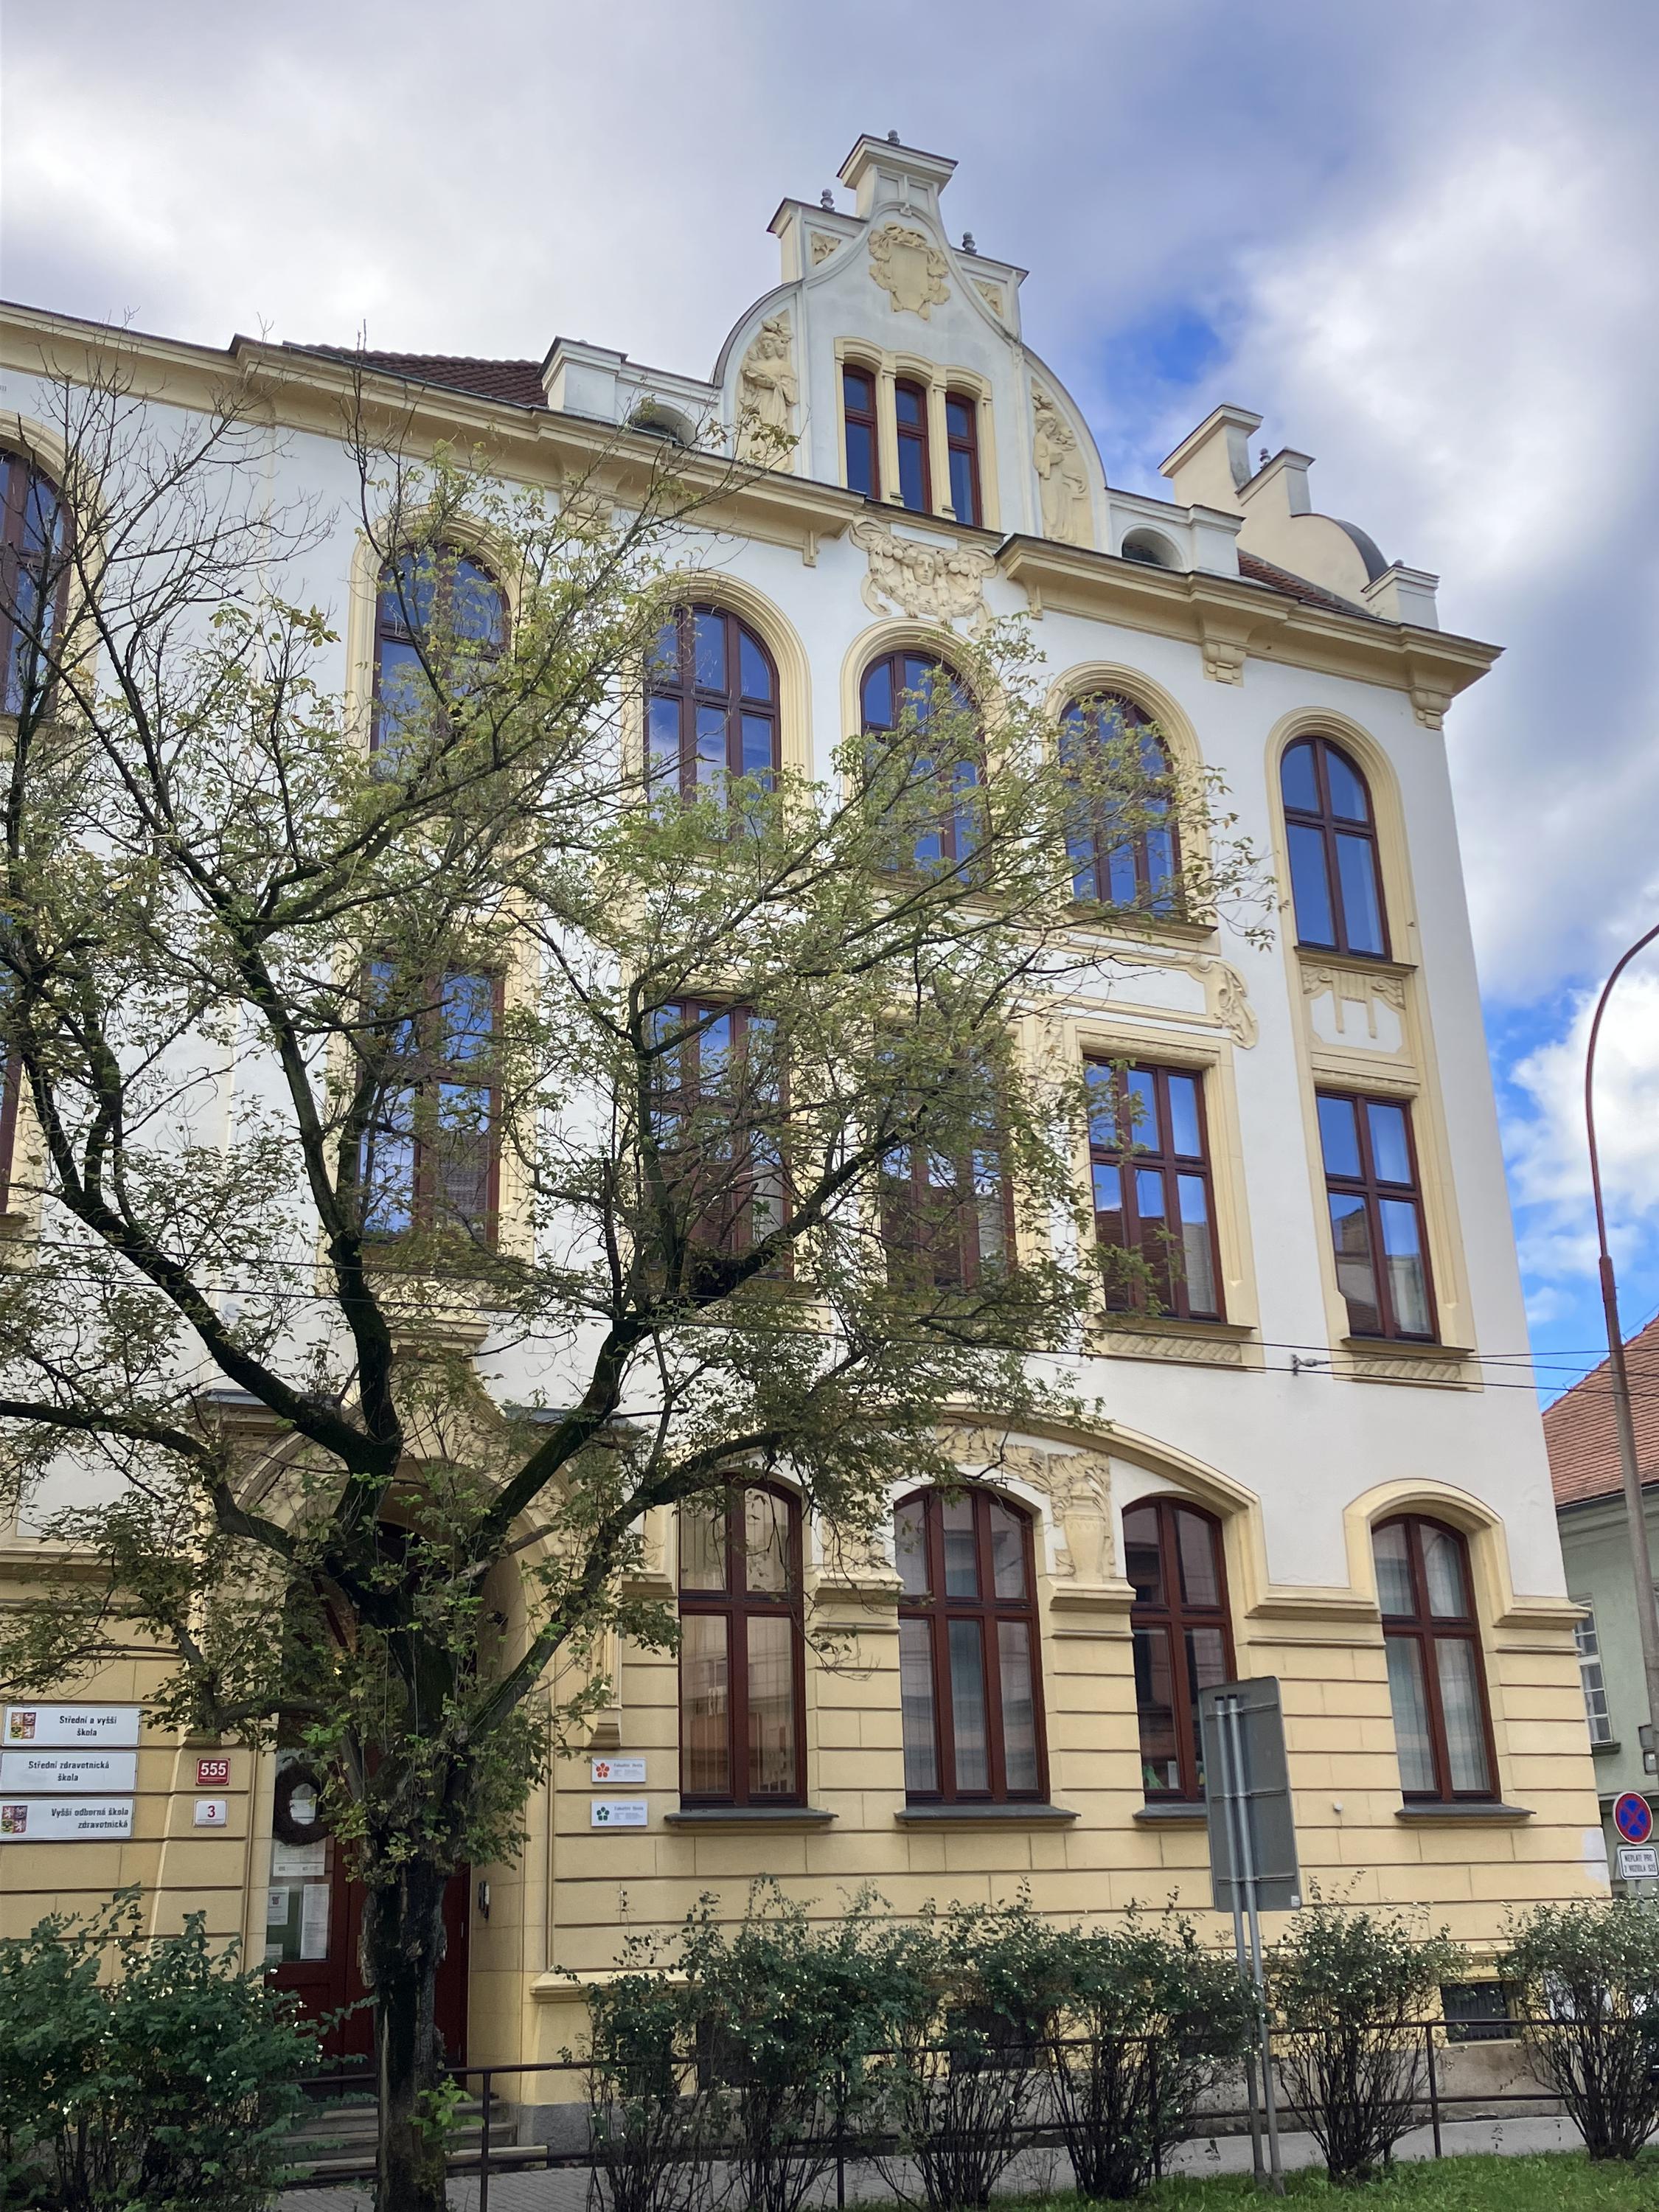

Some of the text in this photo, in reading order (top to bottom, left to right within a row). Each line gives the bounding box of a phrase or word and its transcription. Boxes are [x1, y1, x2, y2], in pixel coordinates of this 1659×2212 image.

[59, 1715, 87, 1724] Střední
[97, 1716, 117, 1726] vyšší
[77, 1728, 97, 1736] škola
[28, 1761, 110, 1770] Střední zdravotnická
[201, 1763, 226, 1776] 555
[58, 1773, 79, 1781] škola
[51, 1807, 129, 1819] Vyšší odborná škola
[207, 1805, 215, 1818] 3
[77, 1820, 128, 1829] zdravotnická
